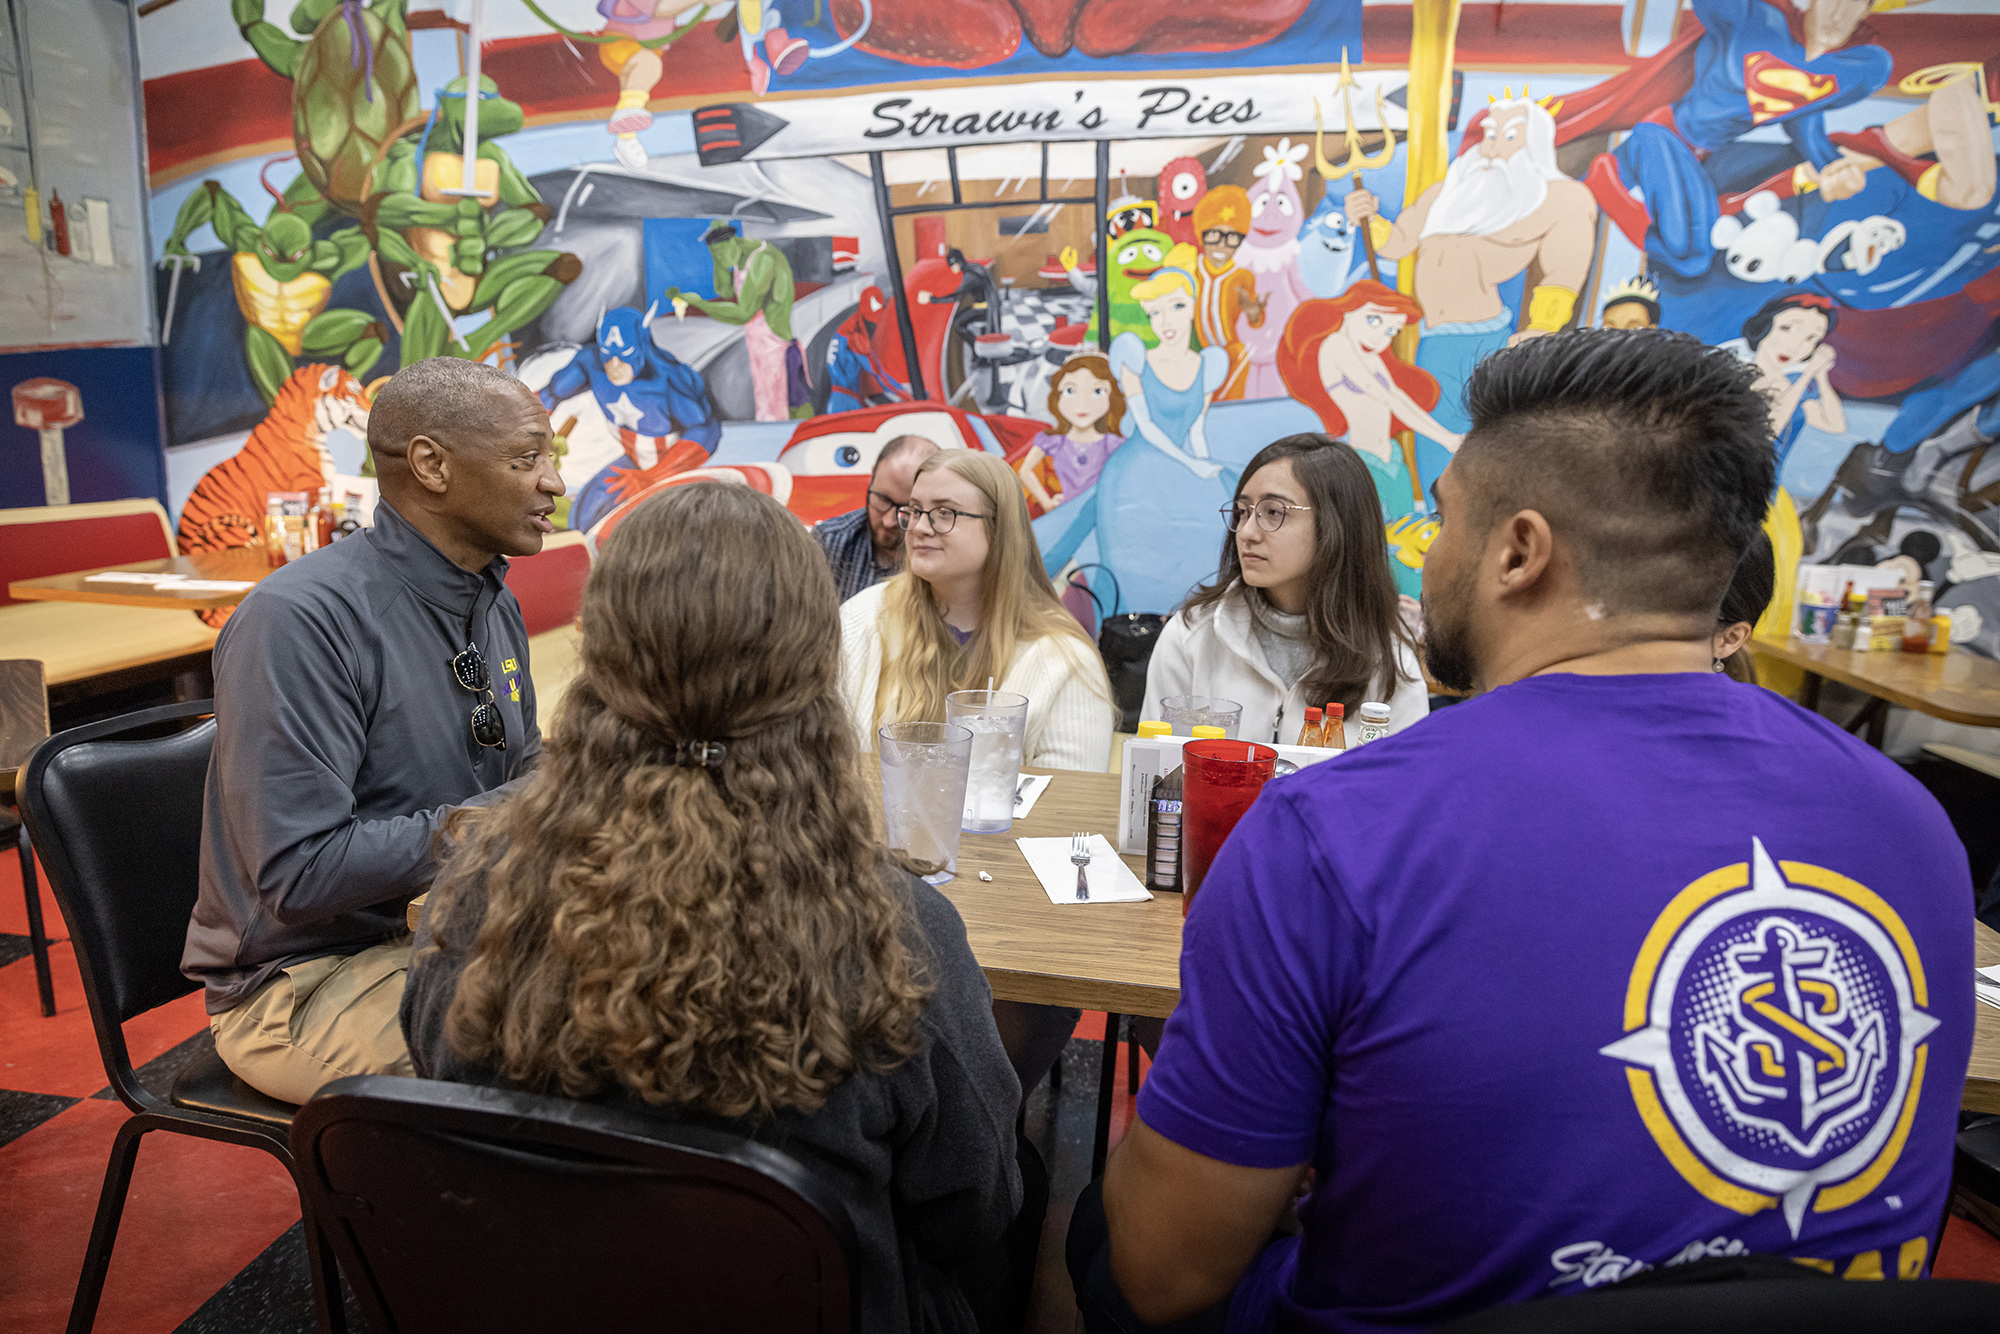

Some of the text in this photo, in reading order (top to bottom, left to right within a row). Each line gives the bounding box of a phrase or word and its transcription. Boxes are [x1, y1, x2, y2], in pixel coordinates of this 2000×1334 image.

[863, 86, 1262, 139] Strawn's Pies
[604, 325, 625, 348] A
[500, 657, 518, 675] LSU
[1365, 732, 1377, 740] 57
